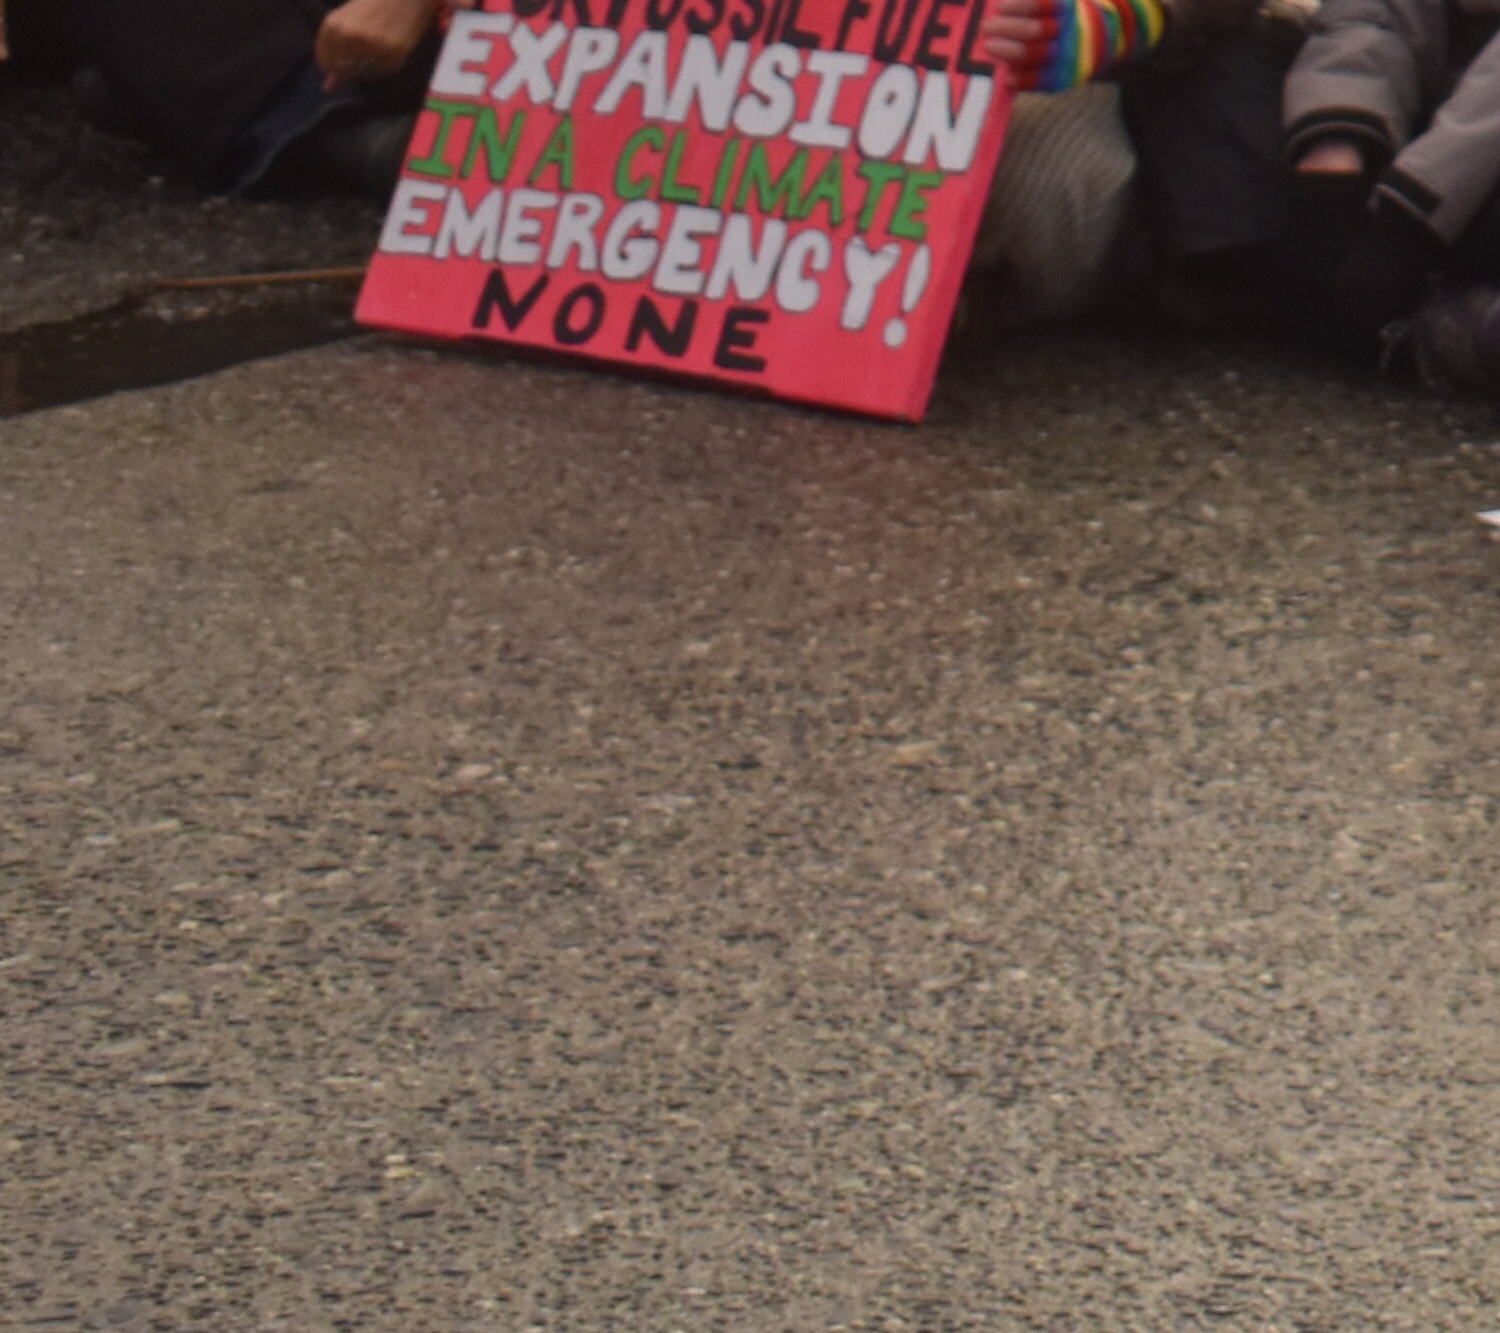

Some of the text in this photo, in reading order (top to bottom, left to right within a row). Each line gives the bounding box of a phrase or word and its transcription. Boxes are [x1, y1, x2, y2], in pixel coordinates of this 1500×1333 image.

[429, 8, 992, 173] EXPANSION
[408, 98, 945, 241] IN A CLIMATE
[377, 177, 932, 351] EMERGENCY!
[472, 268, 771, 373] NONE
